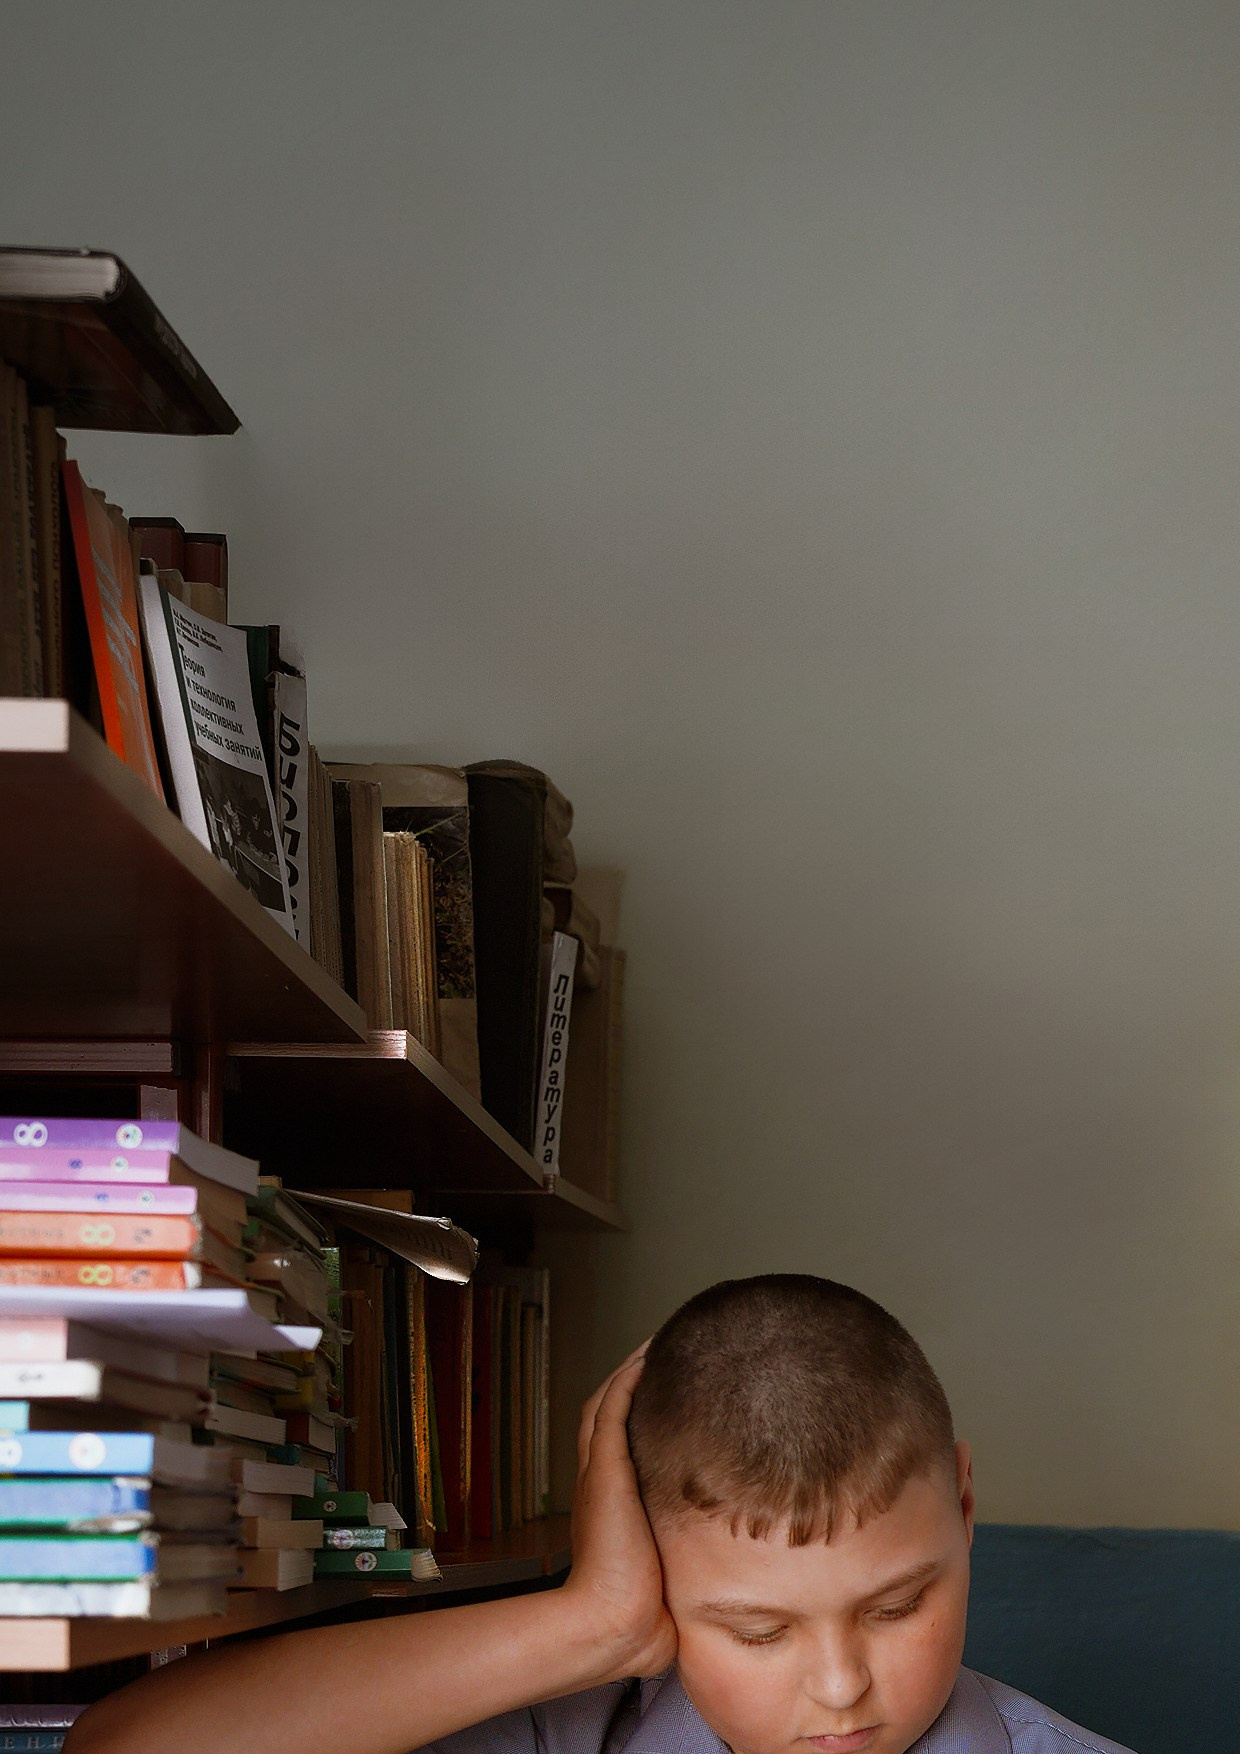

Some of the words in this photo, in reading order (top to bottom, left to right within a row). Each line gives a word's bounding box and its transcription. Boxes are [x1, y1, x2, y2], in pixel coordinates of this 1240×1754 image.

[178, 642, 206, 678] Теория
[191, 680, 237, 713] технология
[190, 698, 245, 736] коллективных
[225, 738, 264, 762] занятий
[543, 974, 569, 1164] Литература
